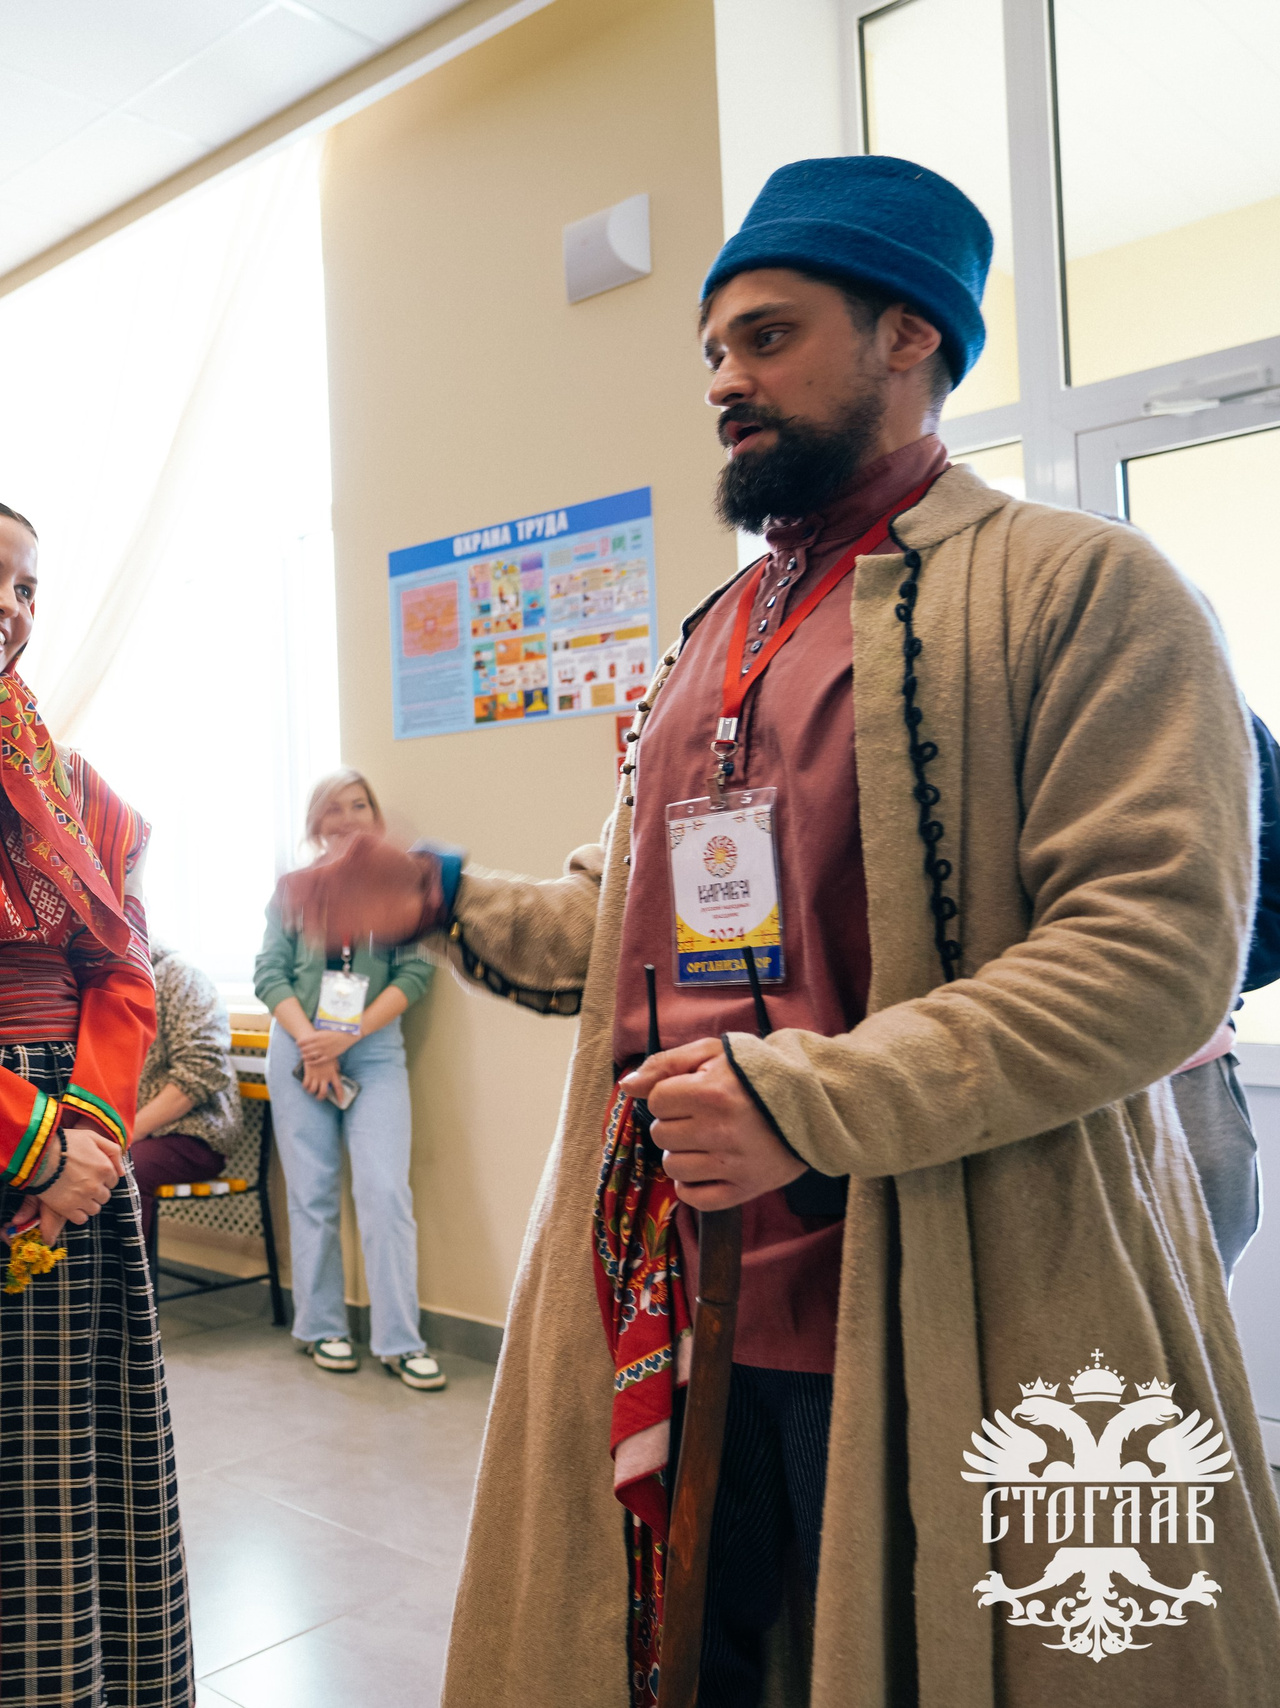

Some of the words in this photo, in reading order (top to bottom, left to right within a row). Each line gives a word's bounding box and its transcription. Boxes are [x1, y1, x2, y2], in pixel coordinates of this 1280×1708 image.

[453, 525, 511, 556] ОХРАНА
[516, 510, 568, 541] ТРУДА
[709, 927, 745, 944] 2024
[687, 956, 772, 973] ОРГАНИЗАОР
